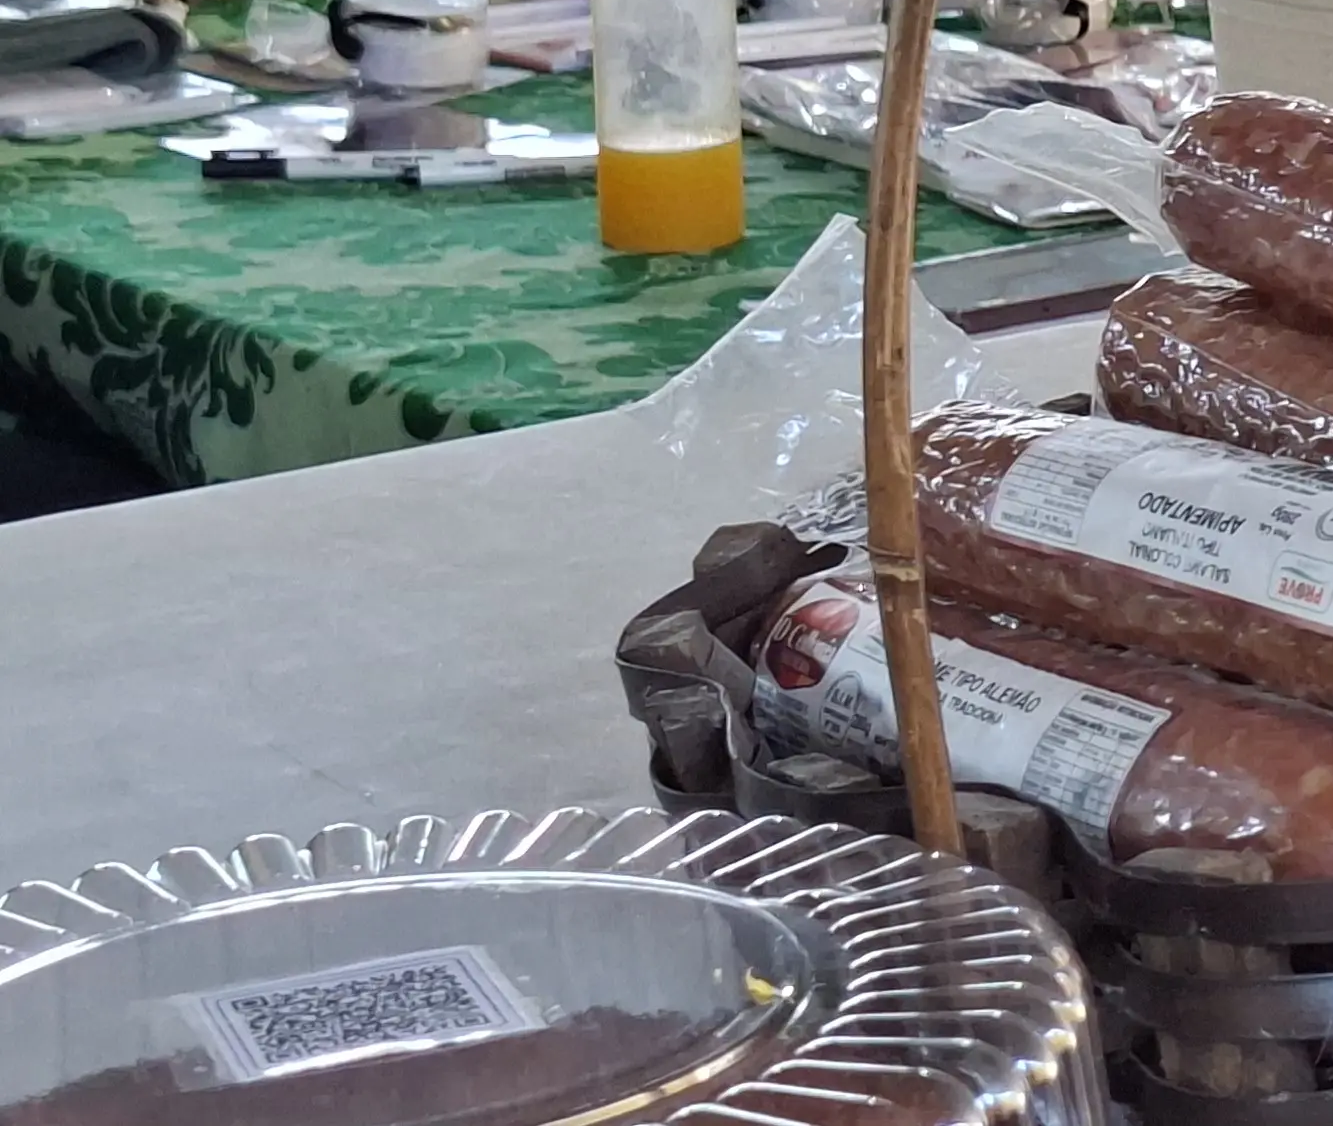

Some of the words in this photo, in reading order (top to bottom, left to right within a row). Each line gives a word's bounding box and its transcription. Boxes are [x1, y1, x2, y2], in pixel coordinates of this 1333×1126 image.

[1137, 492, 1246, 535] APIMENTADO
[1278, 577, 1325, 605] PROVE
[951, 669, 985, 692] TIPO
